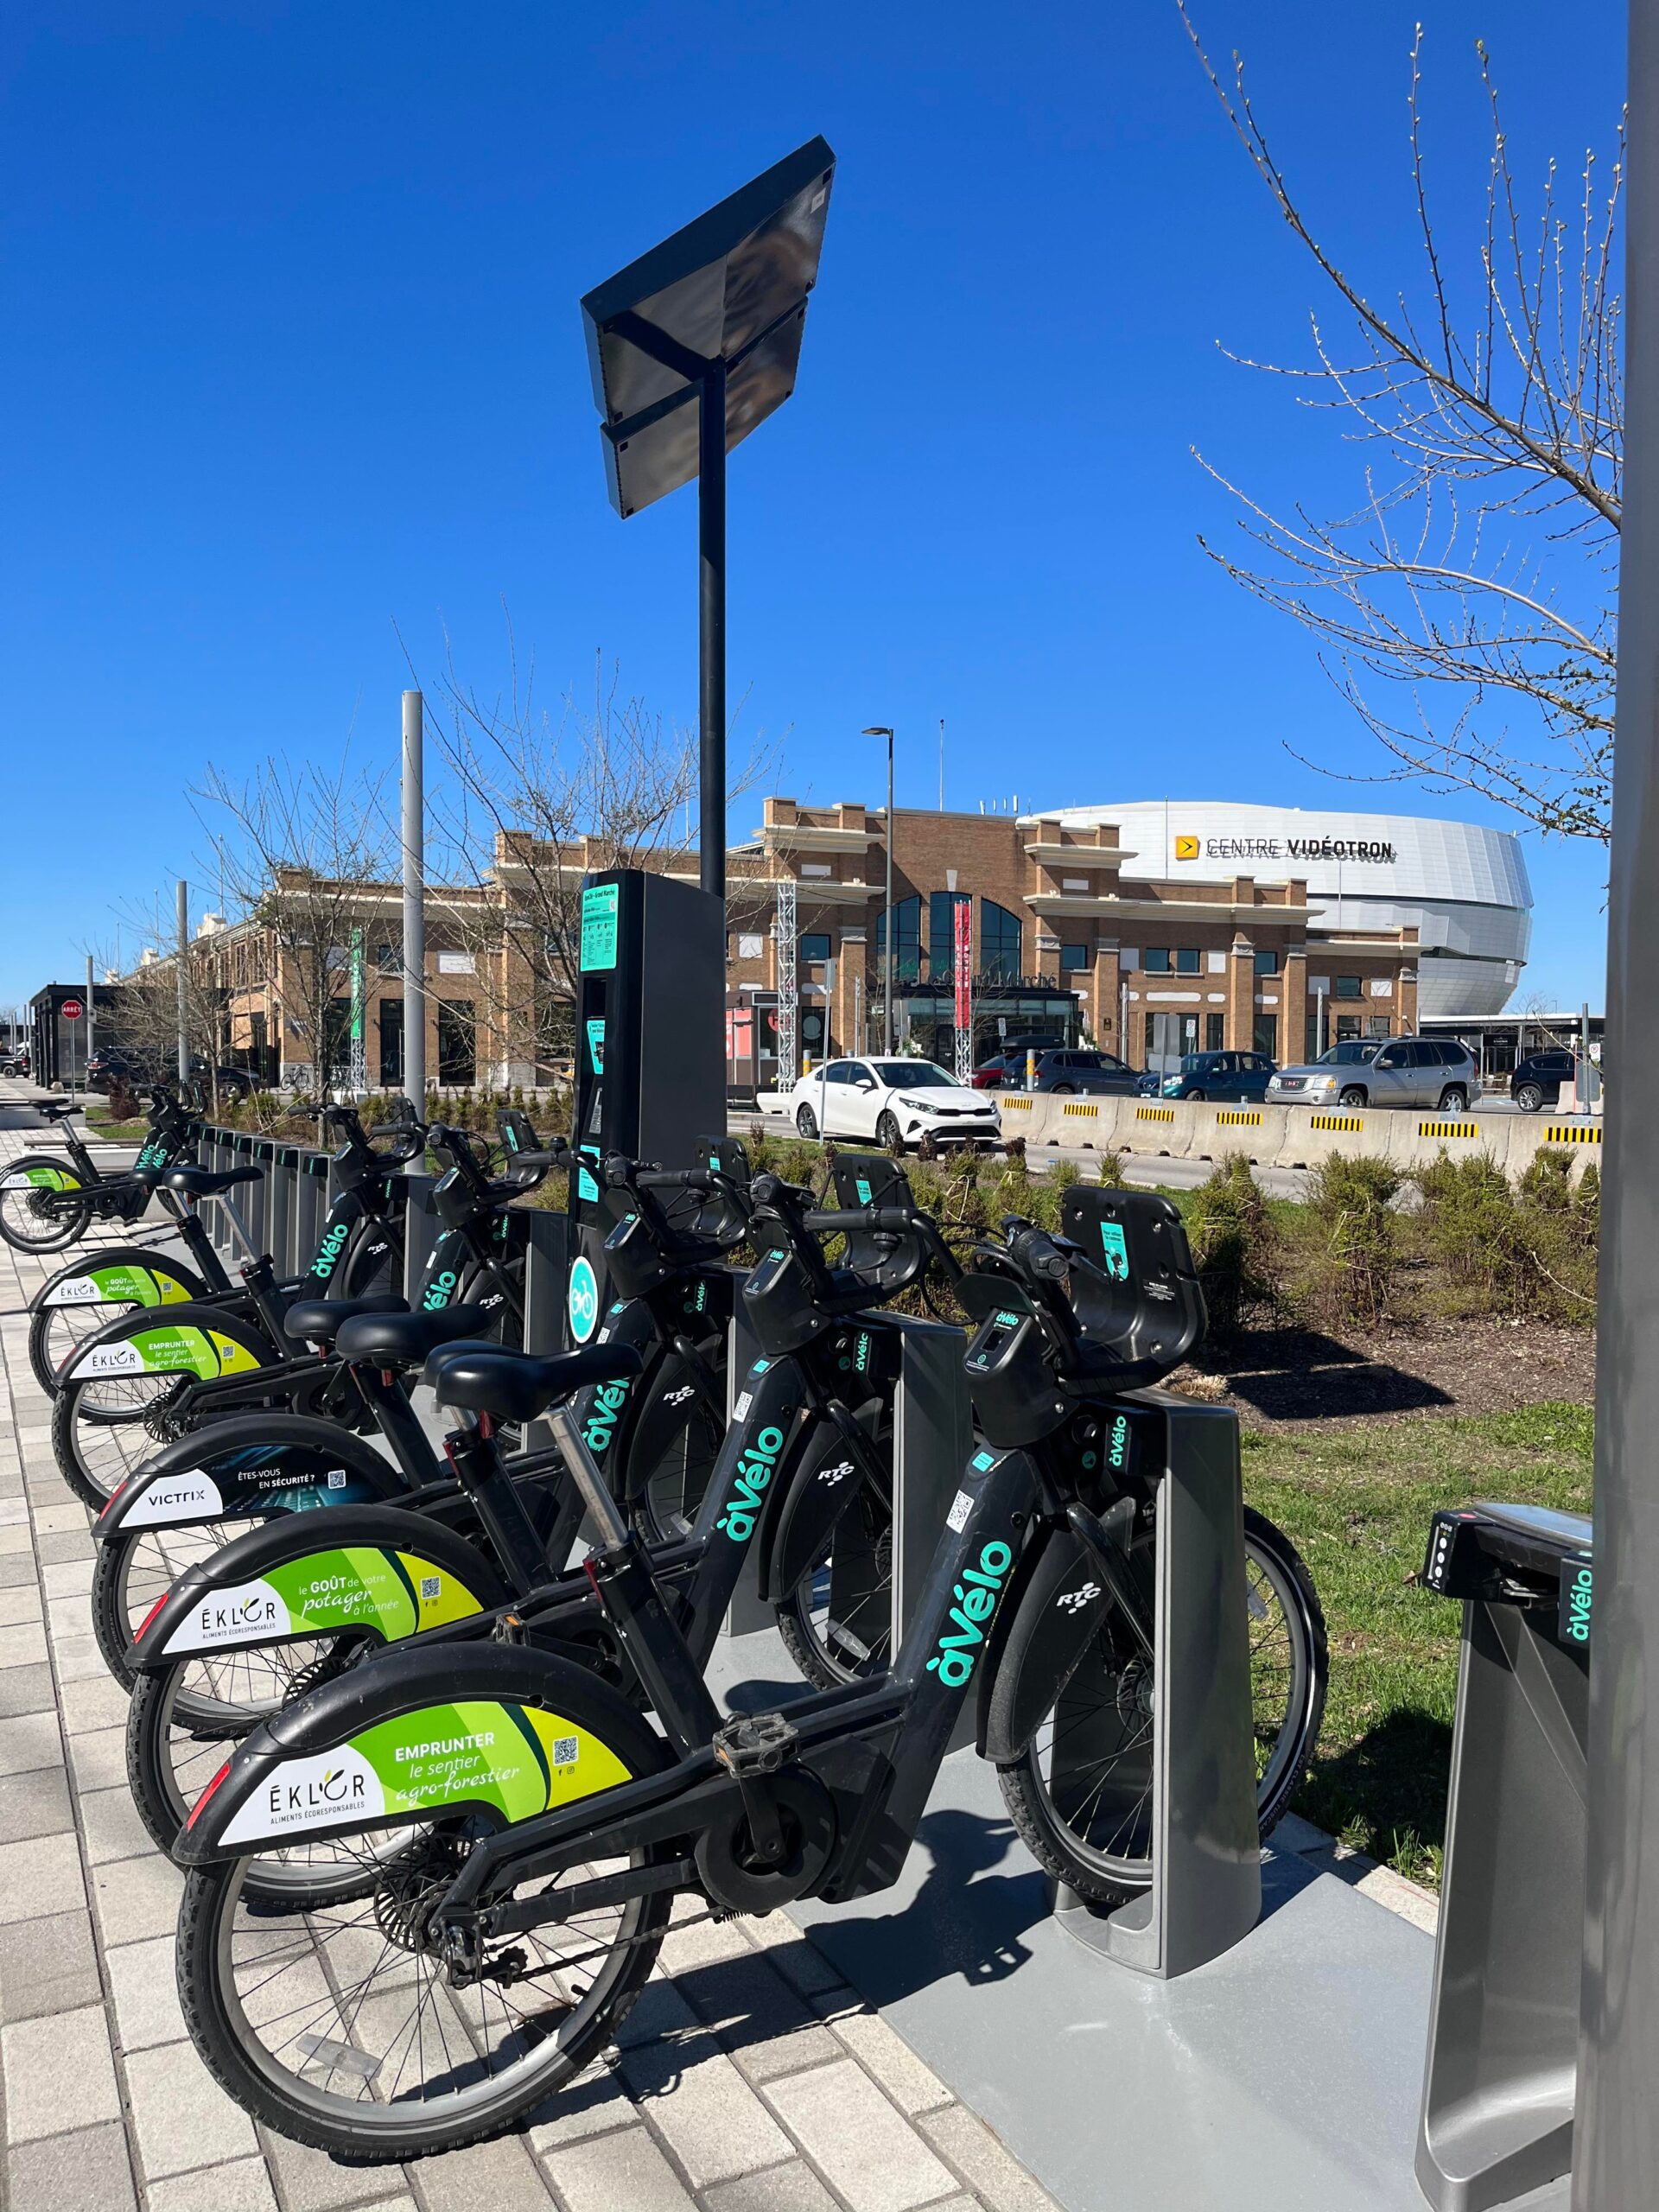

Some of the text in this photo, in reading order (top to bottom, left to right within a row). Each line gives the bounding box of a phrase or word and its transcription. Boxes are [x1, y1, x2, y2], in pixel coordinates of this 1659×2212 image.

[1207, 836, 1392, 859] CENTRE VIDÉOTRON
[310, 1224, 348, 1278] àVélo
[367, 1243, 388, 1252] RTC
[105, 1284, 140, 1296] potager
[480, 1296, 504, 1305] RTC
[995, 1312, 1019, 1325] àVélo
[149, 1340, 195, 1351] EMPRUNTER
[156, 1349, 188, 1358] le sentier
[855, 1332, 868, 1371] àVélo
[149, 1355, 207, 1370] agro-forestier
[664, 1389, 695, 1401] RTC
[1109, 1415, 1127, 1466] àVélo
[238, 1468, 281, 1481] ÊTES-VOUS
[259, 1480, 270, 1489] EN
[271, 1473, 309, 1488] SÉCURITÉ
[817, 1465, 855, 1480] RTC
[716, 1427, 784, 1541] àVélo
[149, 1490, 205, 1506] VICTRIX
[299, 1574, 386, 1595] le GOÛT de votre
[301, 1589, 372, 1619] potager
[1057, 1586, 1102, 1607] RTC
[1567, 1570, 1592, 1641] àVélo
[353, 1599, 399, 1616] à l'année
[926, 1541, 1012, 1688] àVélo
[202, 1623, 276, 1639] ALIMENTS ÉCORESPONSABLES
[395, 1732, 495, 1762] EMPRUNTER
[410, 1754, 480, 1778] le sentier
[396, 1767, 519, 1808] agro-forestier
[1279, 1770, 1299, 1803] CLASSIC
[270, 1801, 365, 1825] ALIMENTS ÉCORESPONSABLES
